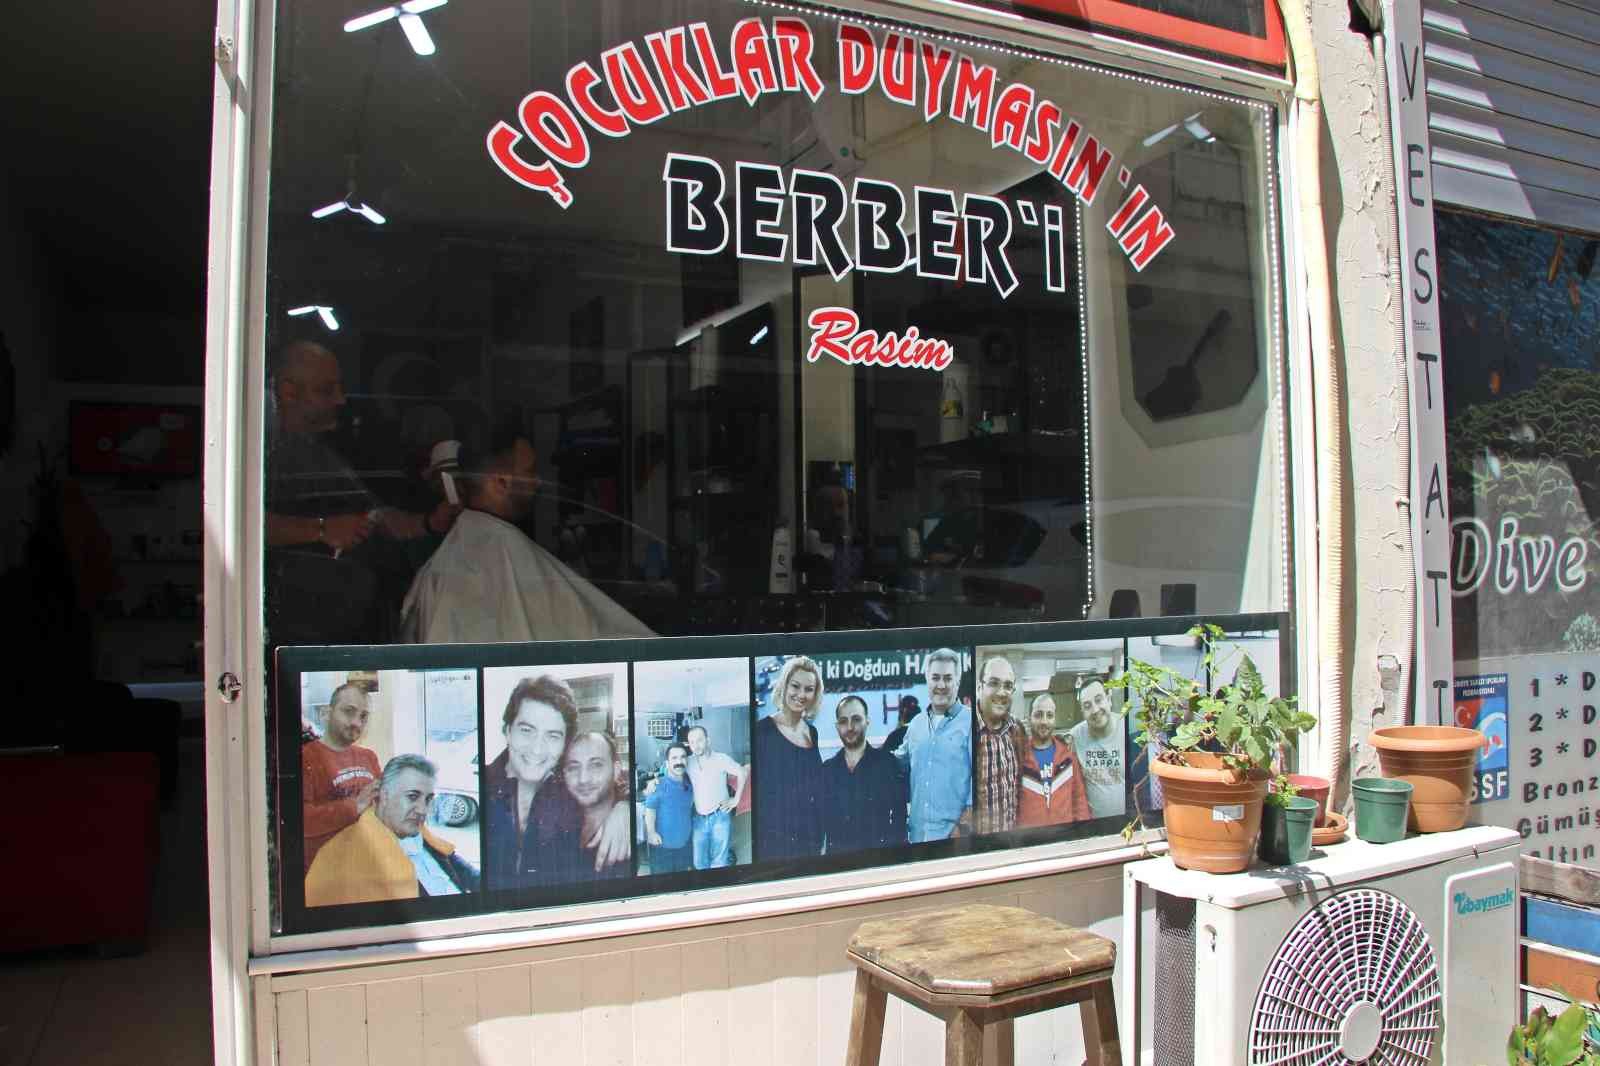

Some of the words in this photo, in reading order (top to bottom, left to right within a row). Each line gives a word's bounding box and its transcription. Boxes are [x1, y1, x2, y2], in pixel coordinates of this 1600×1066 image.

[486, 17, 825, 209] ÇOCUKLAR
[836, 22, 1113, 207] DUYMASIN
[806, 306, 954, 372] Rasim
[1450, 516, 1588, 597] Dive
[844, 658, 900, 681] Doğdun
[1523, 776, 1599, 803] Bronz
